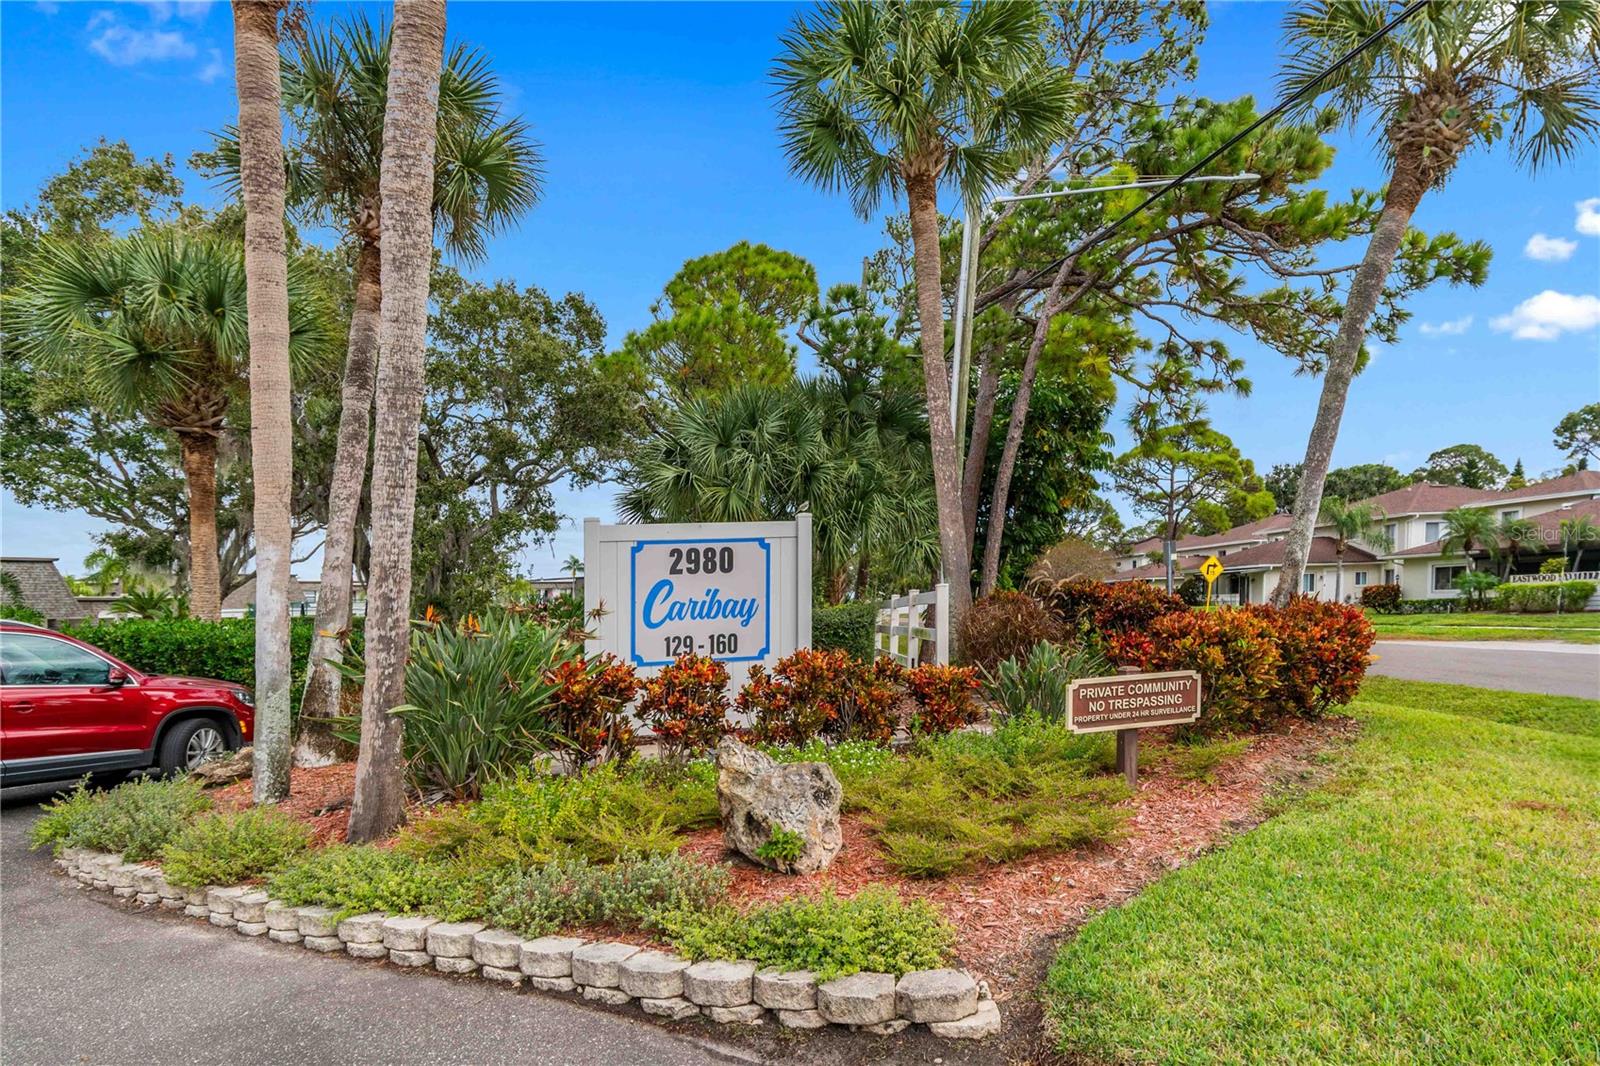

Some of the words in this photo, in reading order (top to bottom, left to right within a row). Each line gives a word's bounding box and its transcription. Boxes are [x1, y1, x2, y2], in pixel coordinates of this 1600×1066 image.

[669, 547, 733, 574] 2980
[1512, 574, 1556, 583] EASTWOOD
[643, 579, 759, 629] Caribay
[664, 635, 693, 657] 129
[708, 633, 738, 654] 160
[1079, 685, 1125, 699] PRIVATE
[1127, 679, 1192, 695] COMMUNITY
[1088, 700, 1105, 712] NO
[1108, 693, 1183, 710] TRESPASSING
[1074, 713, 1109, 723] PROPERTY
[1109, 711, 1131, 720] UNDER
[1132, 710, 1140, 718] 24
[1140, 709, 1150, 717] HR
[1150, 705, 1196, 716] SURVEILLANCE
